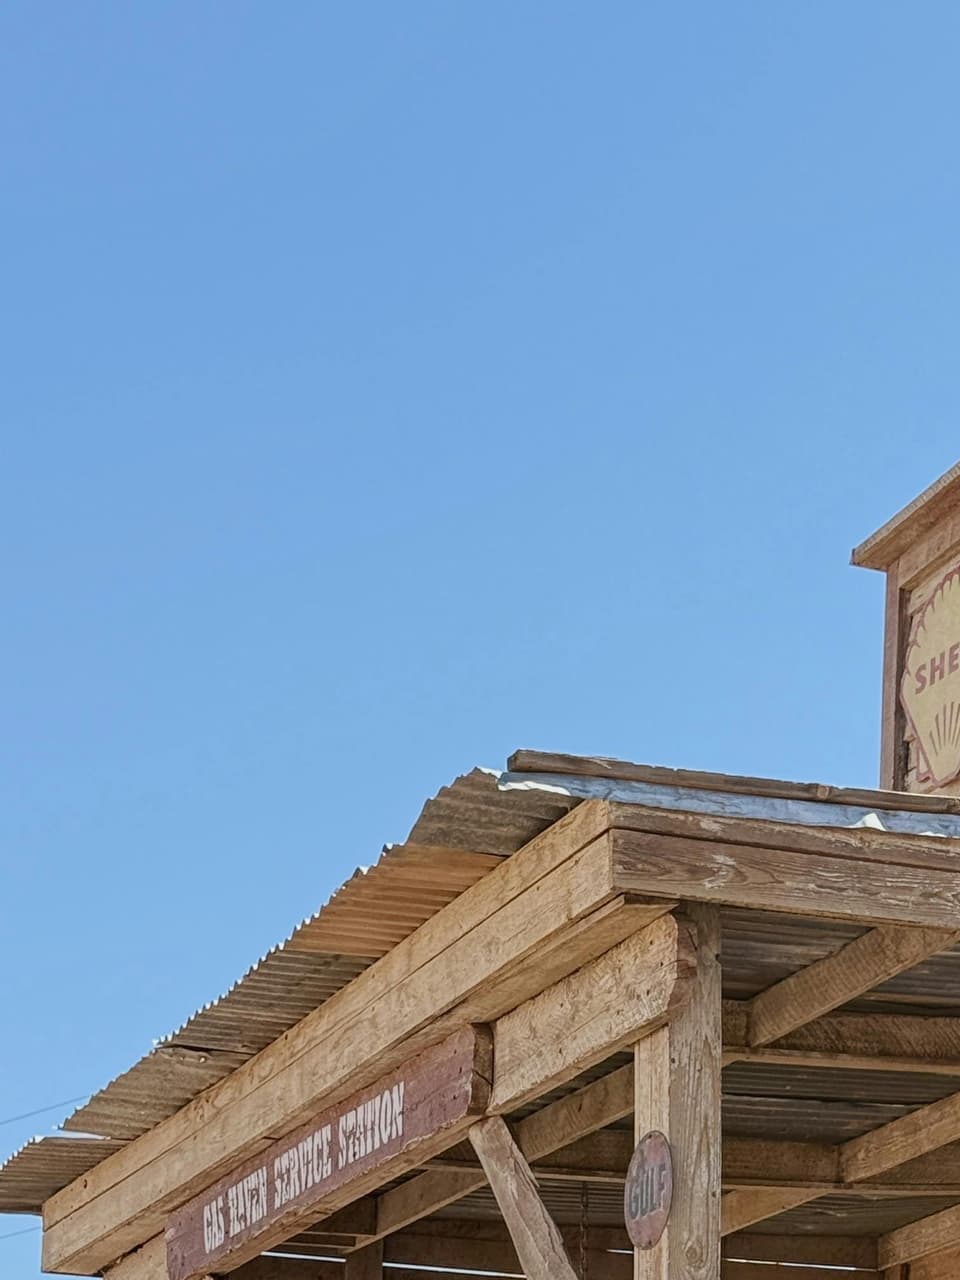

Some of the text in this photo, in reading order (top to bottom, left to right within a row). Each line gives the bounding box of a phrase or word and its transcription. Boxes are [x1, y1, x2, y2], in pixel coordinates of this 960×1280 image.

[203, 1081, 406, 1254] GAS HAVEN SERVICE STATION
